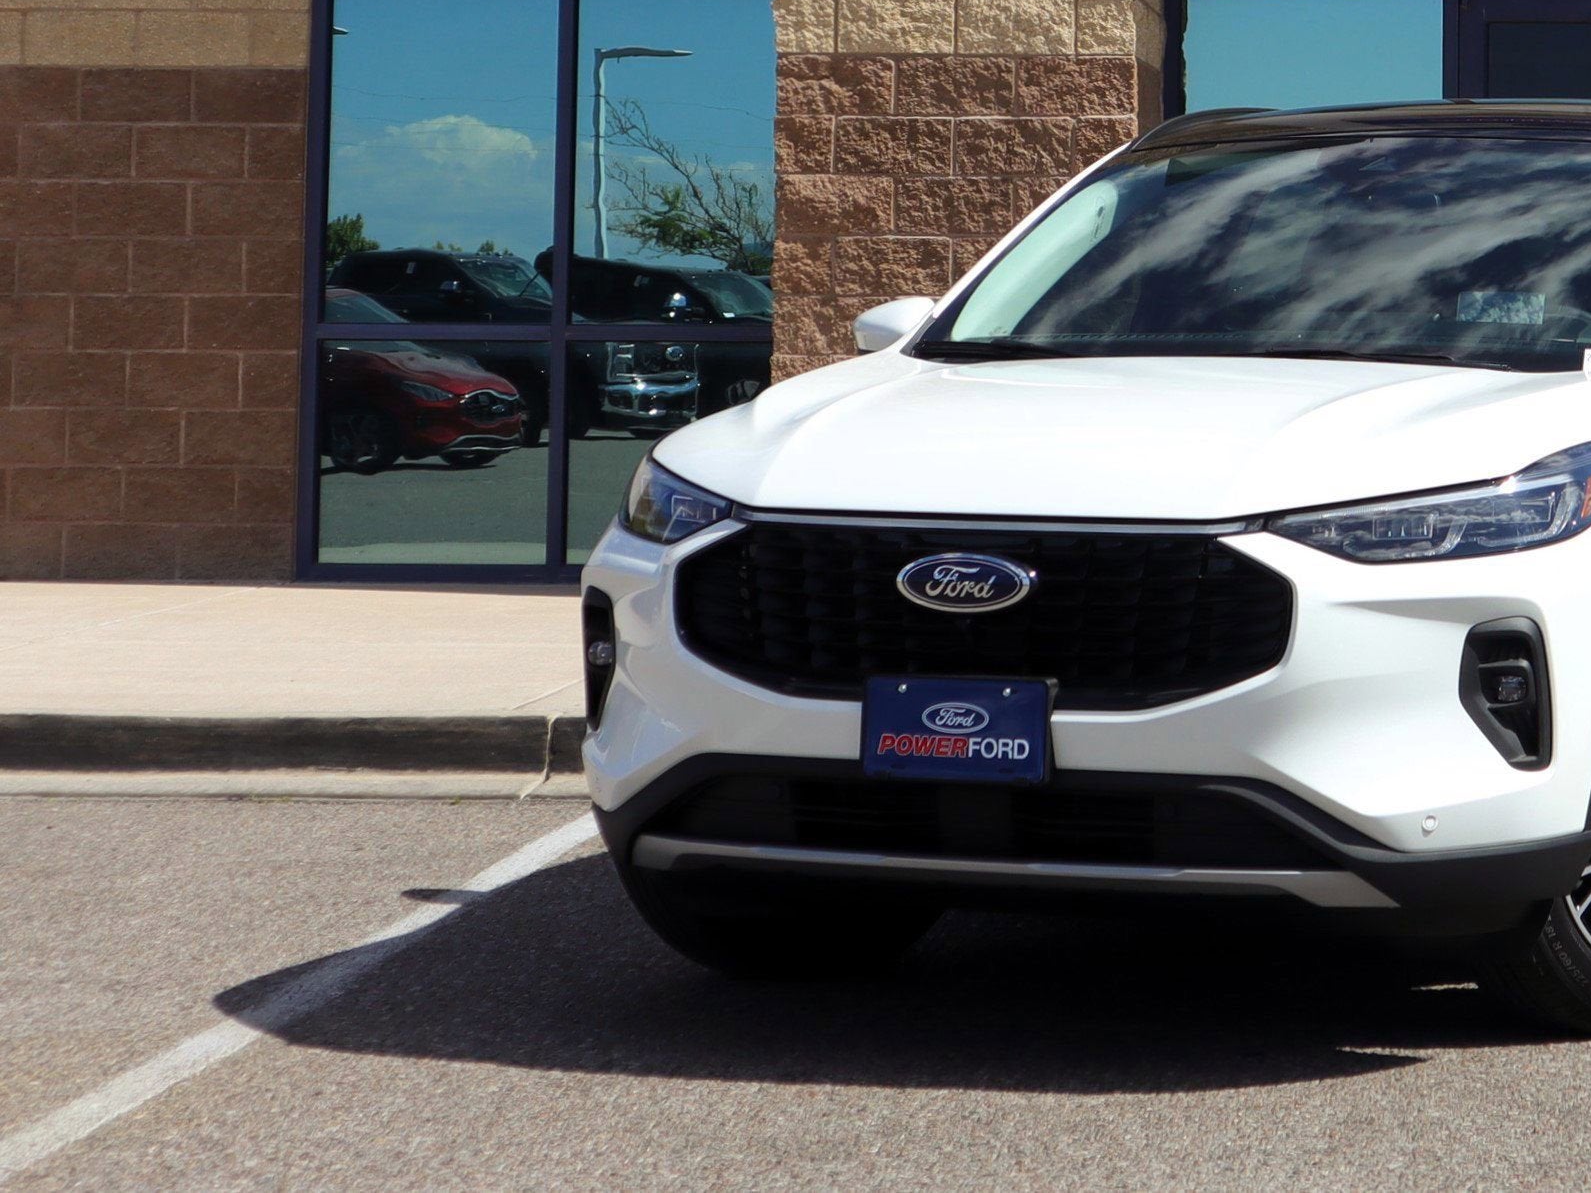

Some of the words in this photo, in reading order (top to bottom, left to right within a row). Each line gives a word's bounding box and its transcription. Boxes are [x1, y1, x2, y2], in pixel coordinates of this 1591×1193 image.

[925, 565, 995, 598] Ford
[935, 708, 976, 727] Ford
[877, 734, 1030, 760] POWERFORD
